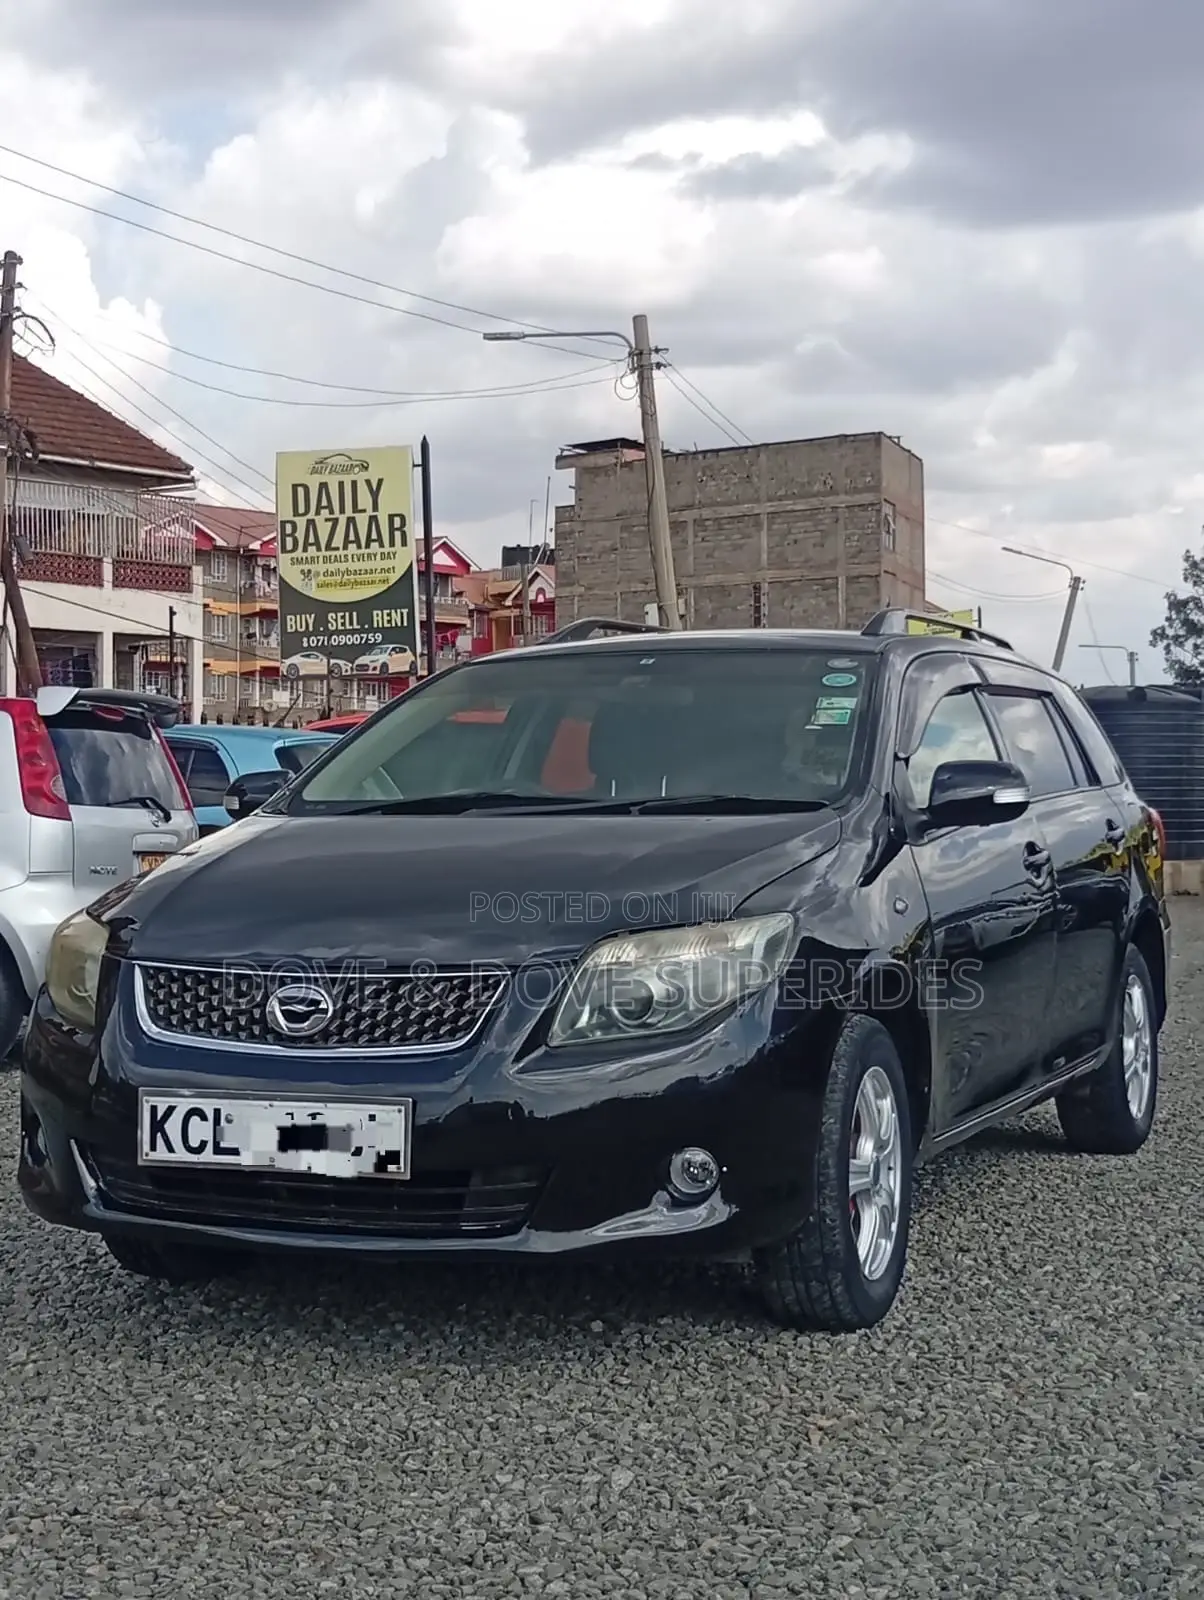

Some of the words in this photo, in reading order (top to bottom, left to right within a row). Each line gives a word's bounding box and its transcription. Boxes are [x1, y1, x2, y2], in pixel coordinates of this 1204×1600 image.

[291, 477, 384, 517] DAILY
[279, 513, 408, 555] BAZAAR
[290, 556, 320, 566] SMART
[322, 554, 349, 564] DEALS
[351, 553, 377, 562] EVERY
[380, 551, 397, 560] DAY
[322, 566, 396, 579] dailybazaar.net
[286, 613, 316, 633] BUY
[327, 611, 360, 631] SELL
[372, 608, 409, 628] RENT
[309, 632, 383, 647] 0710900759
